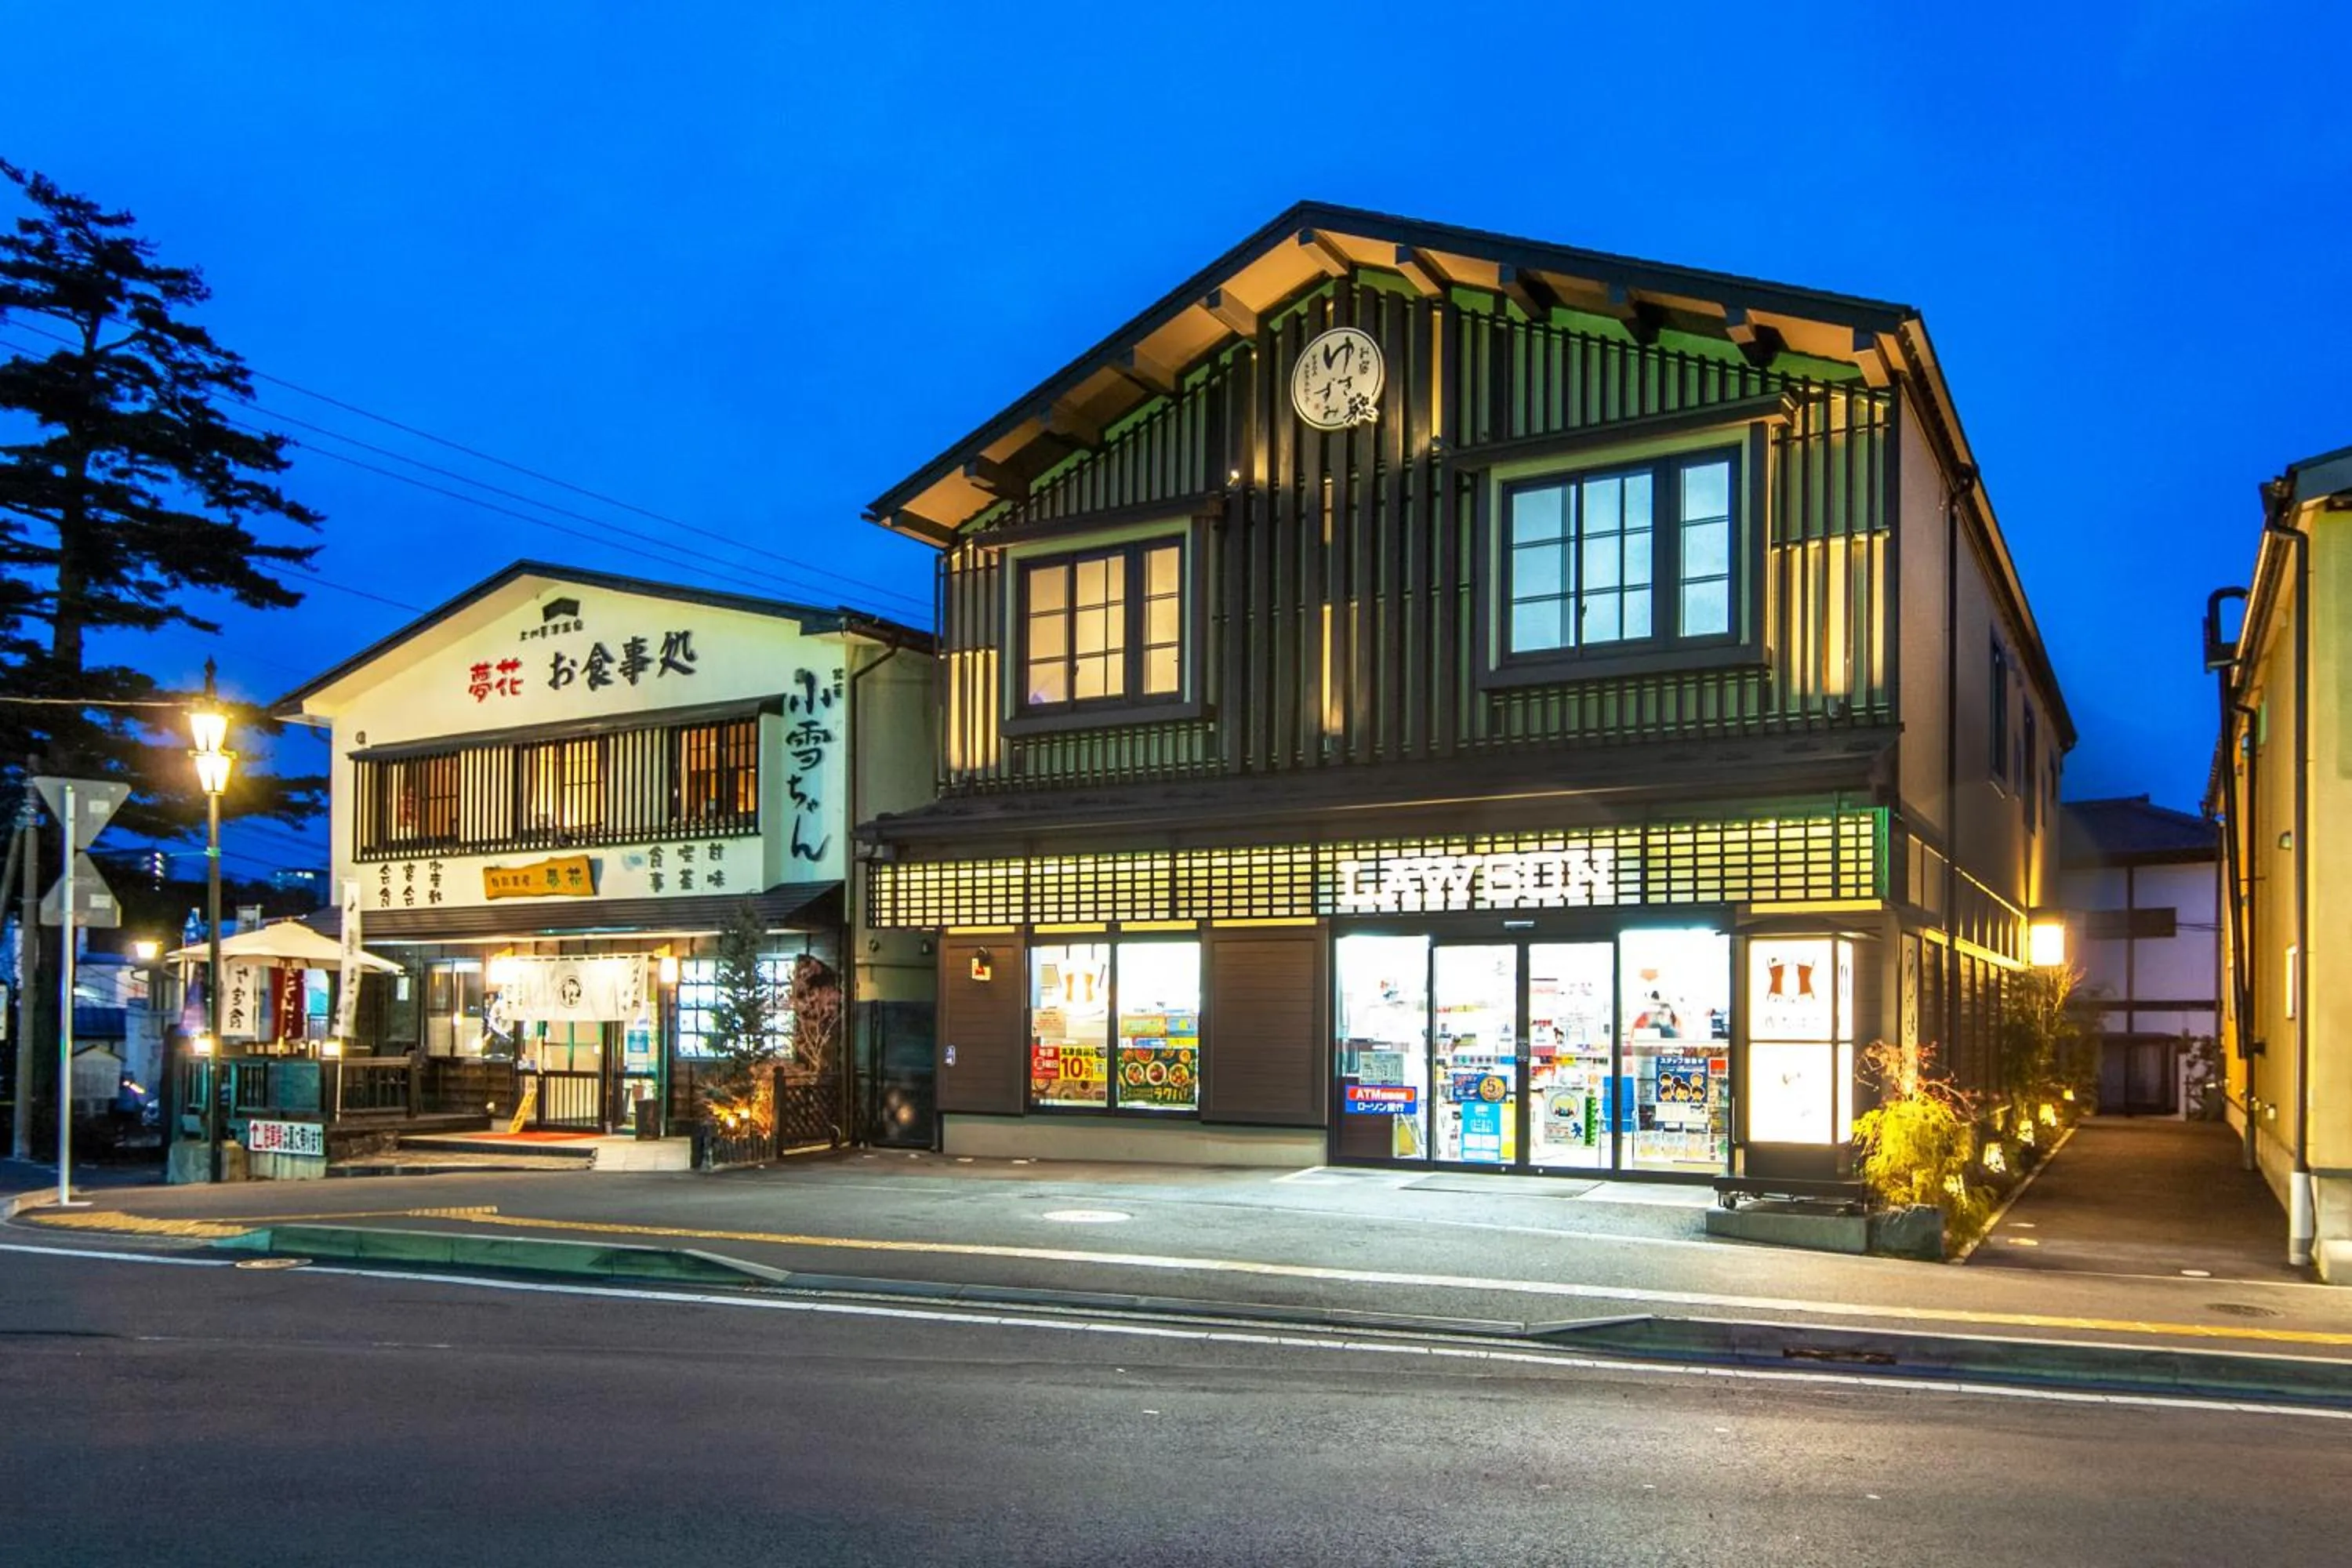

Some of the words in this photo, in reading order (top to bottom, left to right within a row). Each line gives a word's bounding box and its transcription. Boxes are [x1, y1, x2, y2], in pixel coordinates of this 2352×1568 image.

[469, 657, 523, 702] 夢花
[548, 630, 698, 691] お食事処
[785, 671, 833, 862] 小雪ちゃん
[648, 846, 664, 893] 食事
[1336, 849, 1614, 906] LAWSON
[1062, 1056, 1083, 1078] 10
[1356, 1087, 1381, 1100] ATM
